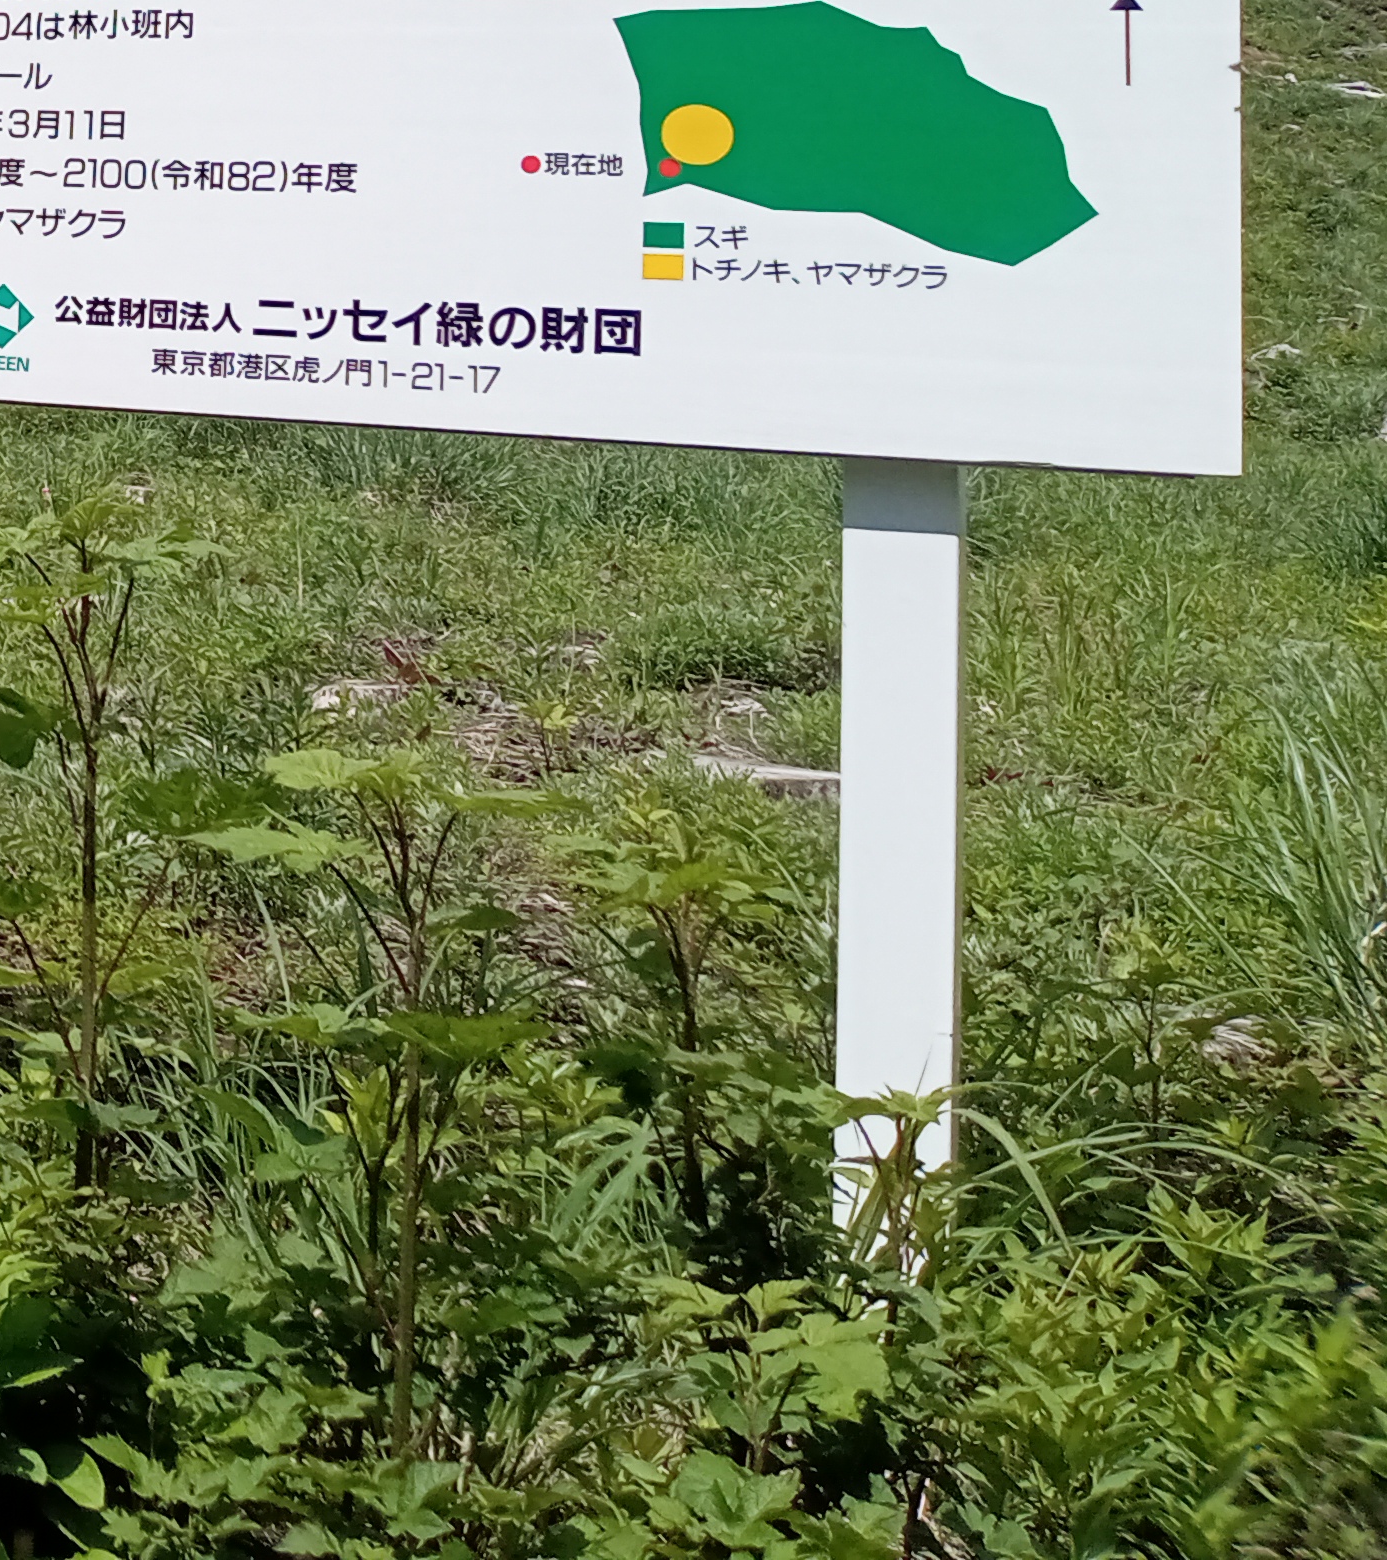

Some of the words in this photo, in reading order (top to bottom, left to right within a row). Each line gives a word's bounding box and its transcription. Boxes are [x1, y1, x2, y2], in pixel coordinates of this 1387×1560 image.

[543, 152, 624, 177] 現在地
[693, 225, 749, 251] スギ
[691, 256, 948, 290] トチノキ、ヤマザクラ
[54, 295, 243, 334] 公益財団法人
[250, 298, 643, 357] ニッセイ緑の財団
